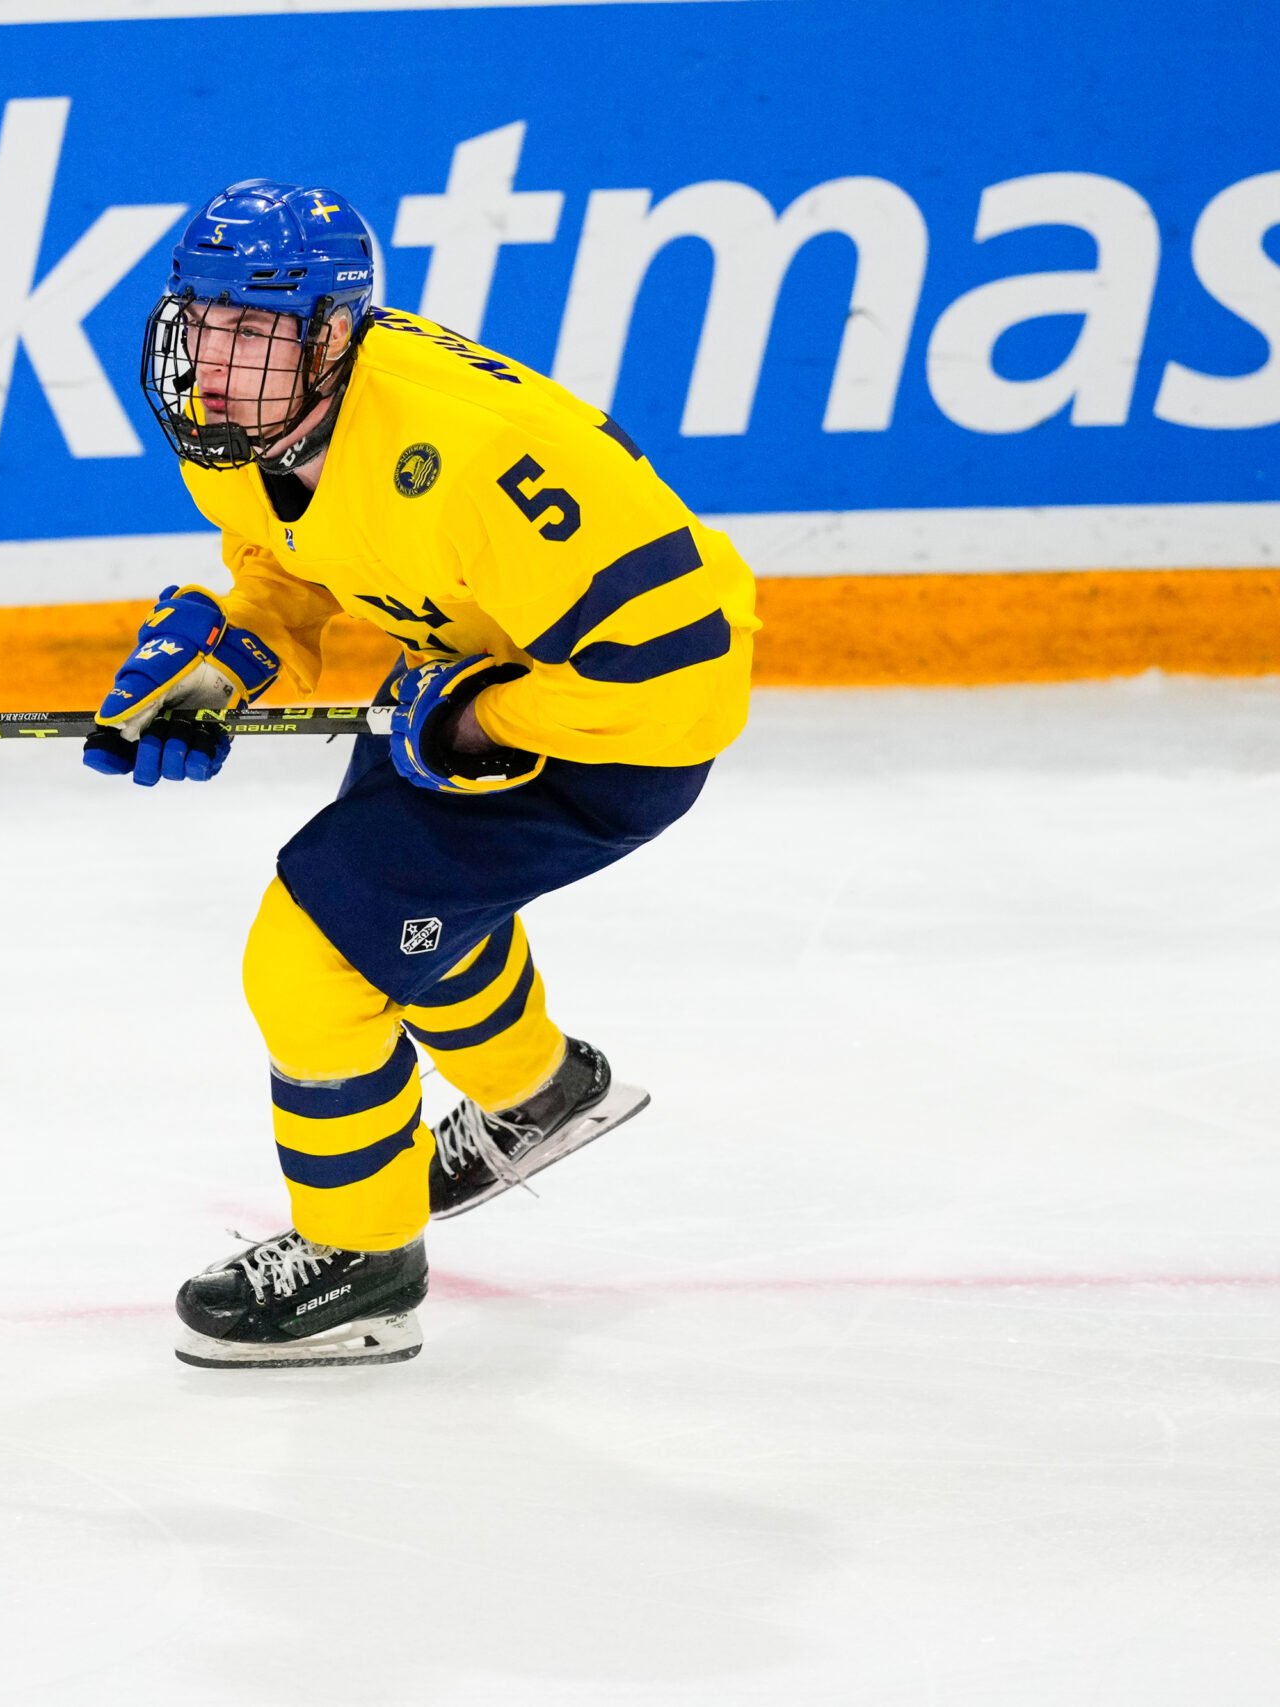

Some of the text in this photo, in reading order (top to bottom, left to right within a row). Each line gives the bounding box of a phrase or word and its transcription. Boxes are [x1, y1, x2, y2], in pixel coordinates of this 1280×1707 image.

[210, 223, 228, 244] 5
[336, 270, 369, 282] CCM
[496, 453, 581, 542] 5
[241, 637, 276, 670] CCM
[235, 724, 297, 732] BAUER
[402, 919, 440, 952] TACKLA
[296, 1284, 352, 1316] BAUER
